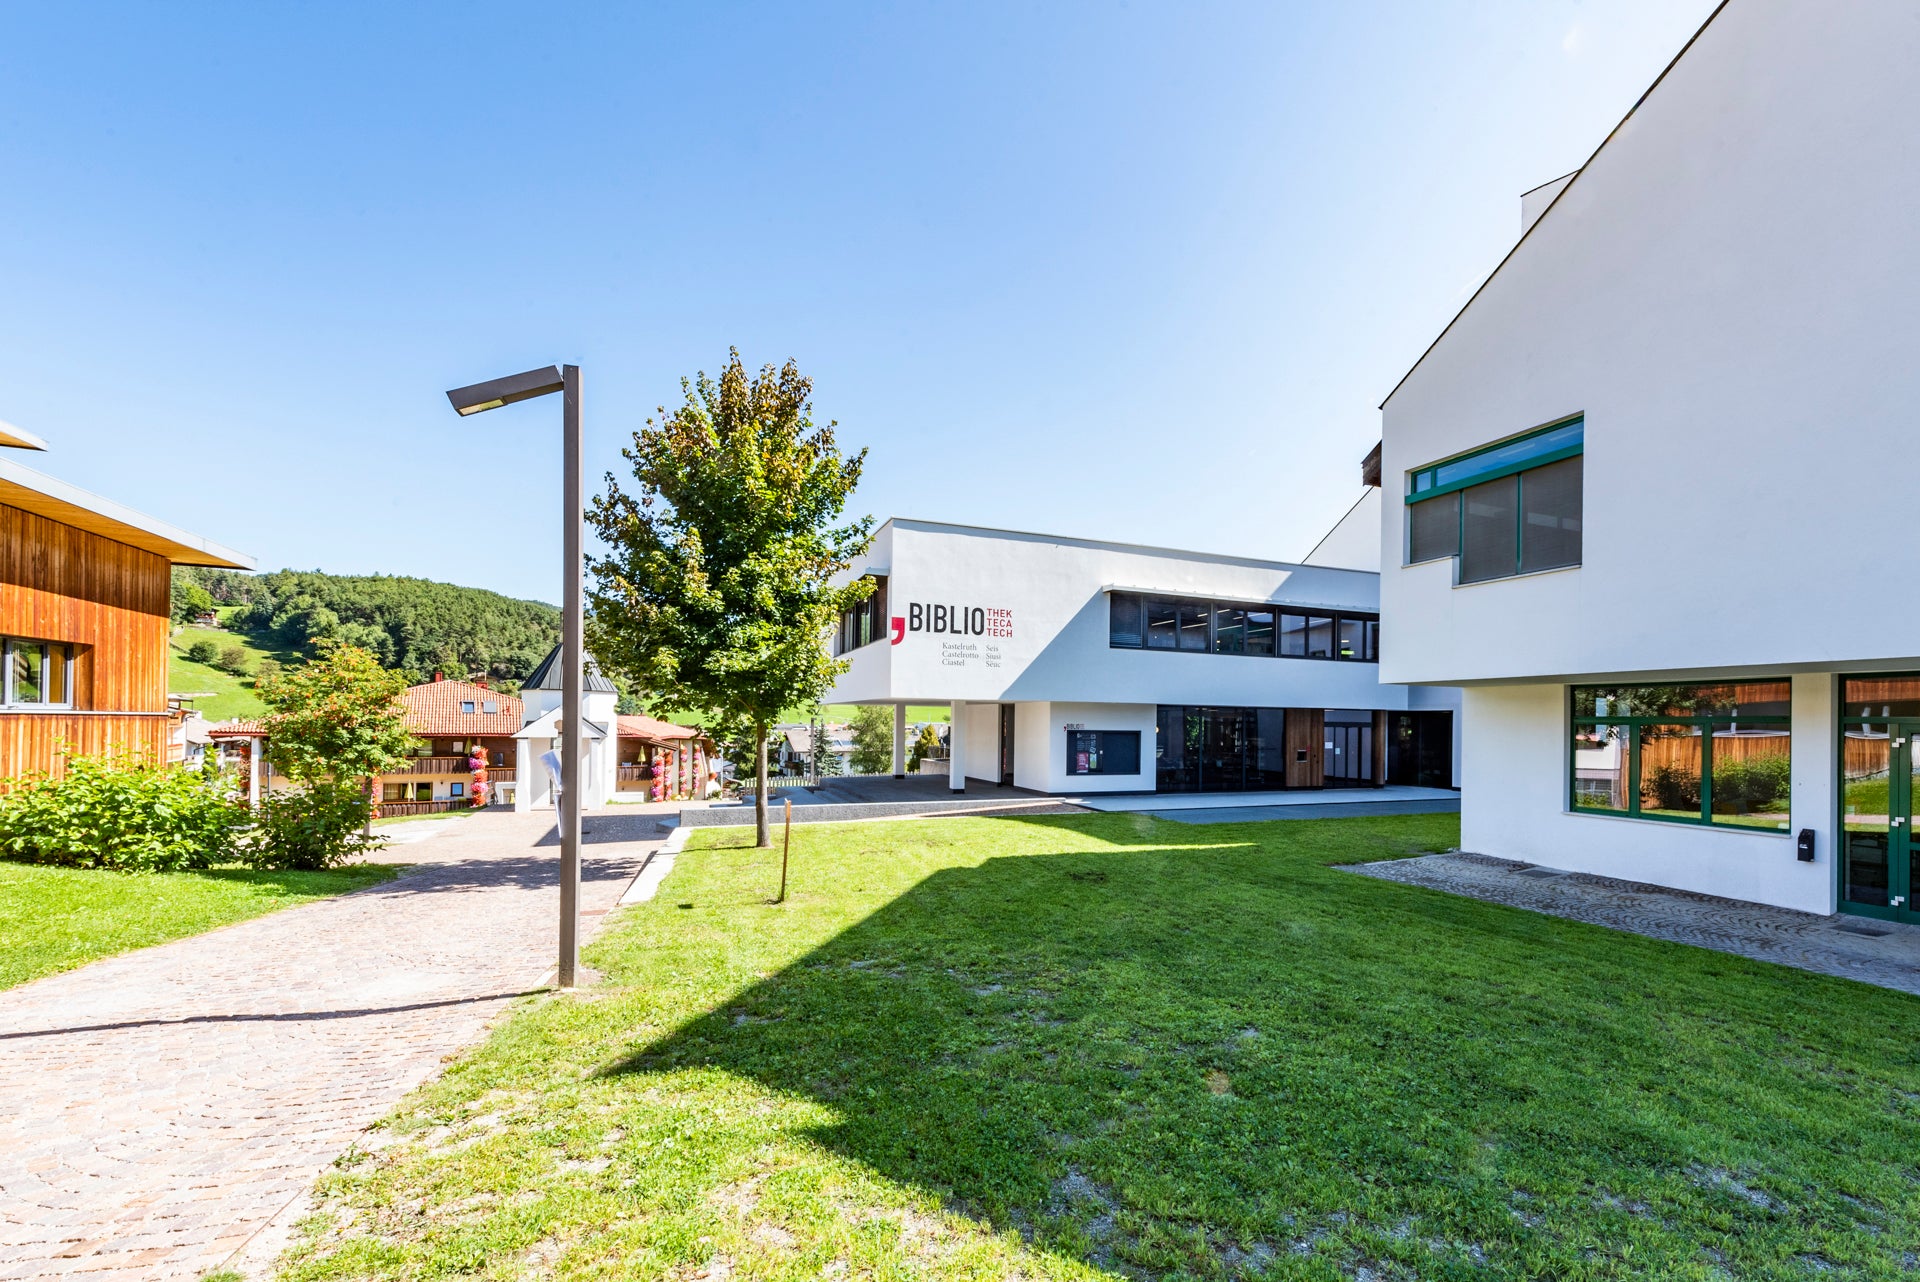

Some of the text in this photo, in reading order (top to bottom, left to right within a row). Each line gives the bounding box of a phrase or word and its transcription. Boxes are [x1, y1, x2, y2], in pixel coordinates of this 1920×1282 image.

[987, 608, 1012, 618] THEK
[909, 602, 985, 636] BIBLIO
[987, 618, 1013, 628] TECA
[987, 628, 1013, 638] TECH
[942, 642, 977, 651] Kastelruth
[942, 650, 979, 659] Castelrotto
[942, 659, 965, 667] Ciastel
